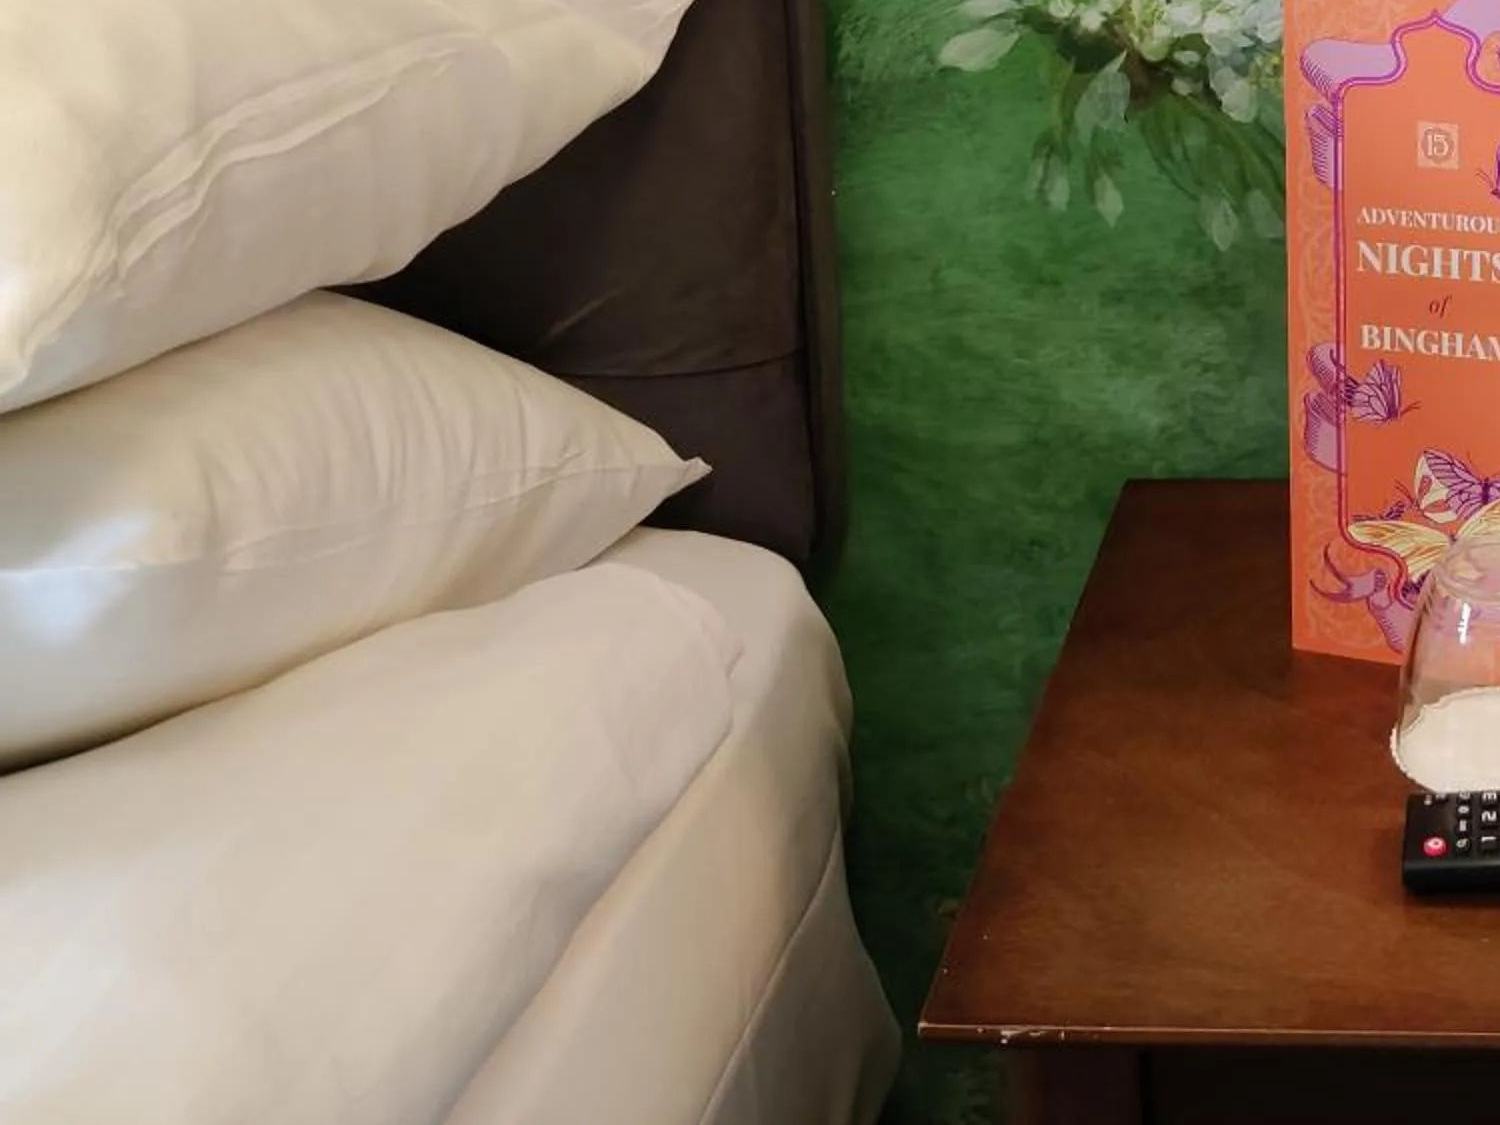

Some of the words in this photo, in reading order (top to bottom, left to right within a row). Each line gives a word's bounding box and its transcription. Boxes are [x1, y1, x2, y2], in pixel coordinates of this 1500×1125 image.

[1427, 134, 1449, 155] 15
[1429, 295, 1451, 317] of
[1482, 790, 1497, 800] 3
[1481, 811, 1497, 822] 2
